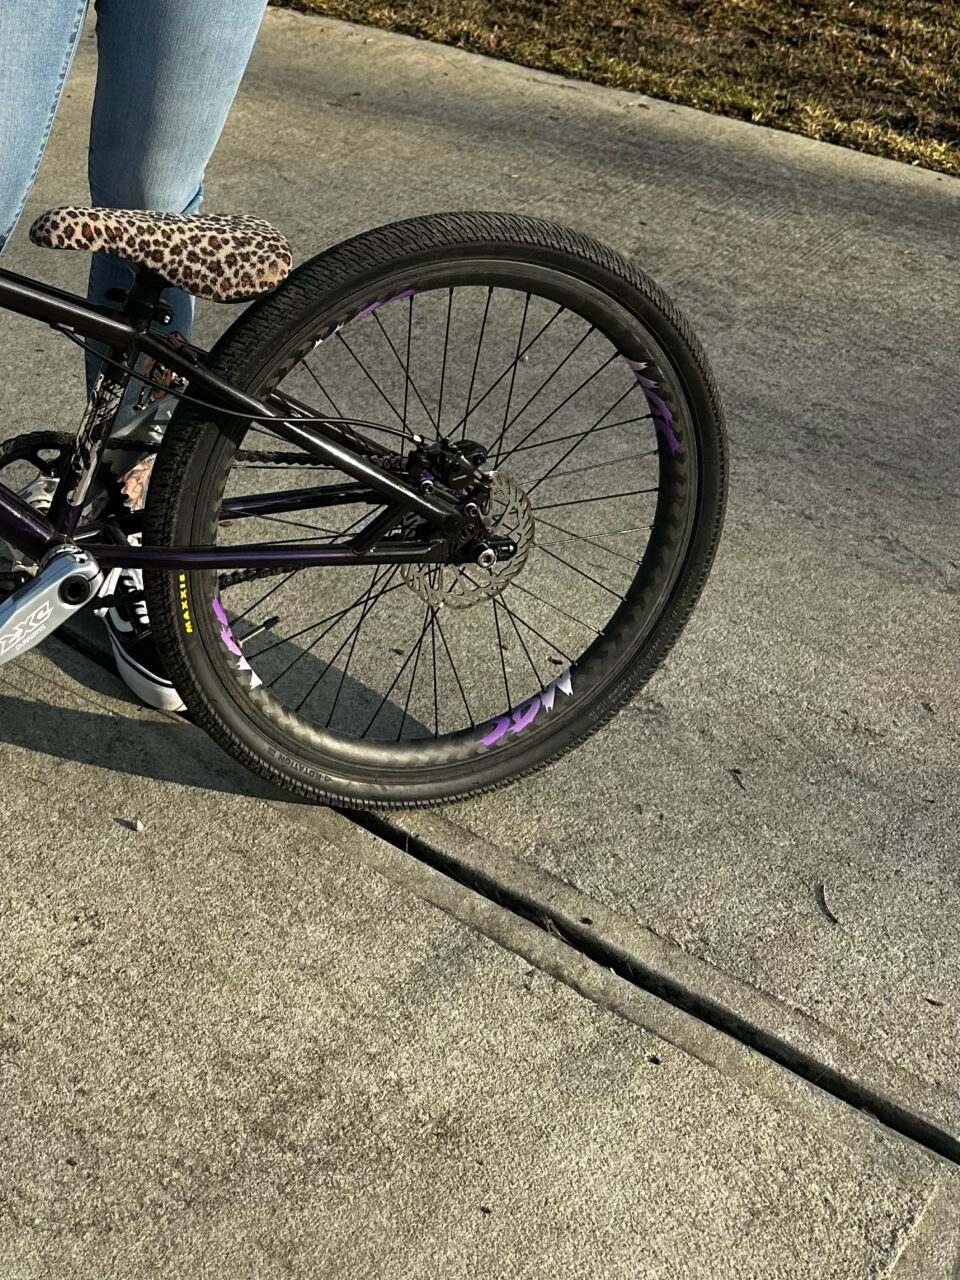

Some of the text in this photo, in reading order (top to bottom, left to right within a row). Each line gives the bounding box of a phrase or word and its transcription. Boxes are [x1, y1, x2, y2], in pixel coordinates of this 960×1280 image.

[179, 573, 193, 633] MAXXIS
[14, 623, 46, 651] SHIMANO
[278, 753, 322, 781] ROTATION
